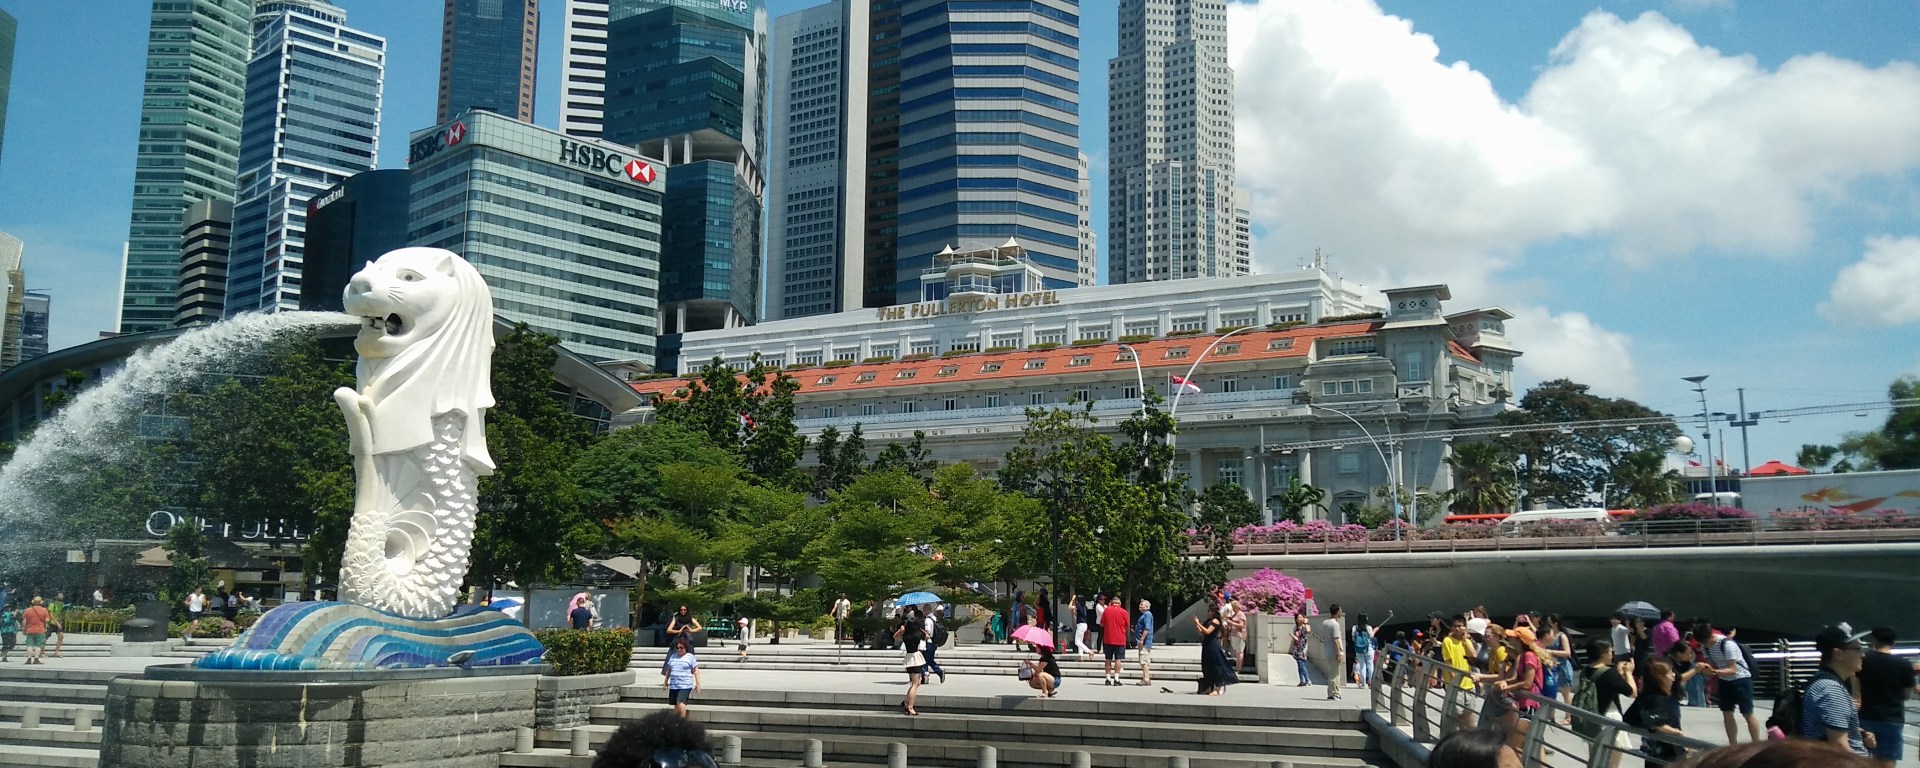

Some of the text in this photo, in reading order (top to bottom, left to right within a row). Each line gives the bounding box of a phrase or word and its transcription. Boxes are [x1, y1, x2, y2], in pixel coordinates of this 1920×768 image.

[720, 0, 748, 12] MYP
[409, 129, 445, 164] HSBC
[559, 138, 623, 174] HSBC
[878, 290, 1060, 321] THE FULLERTON HOTEL
